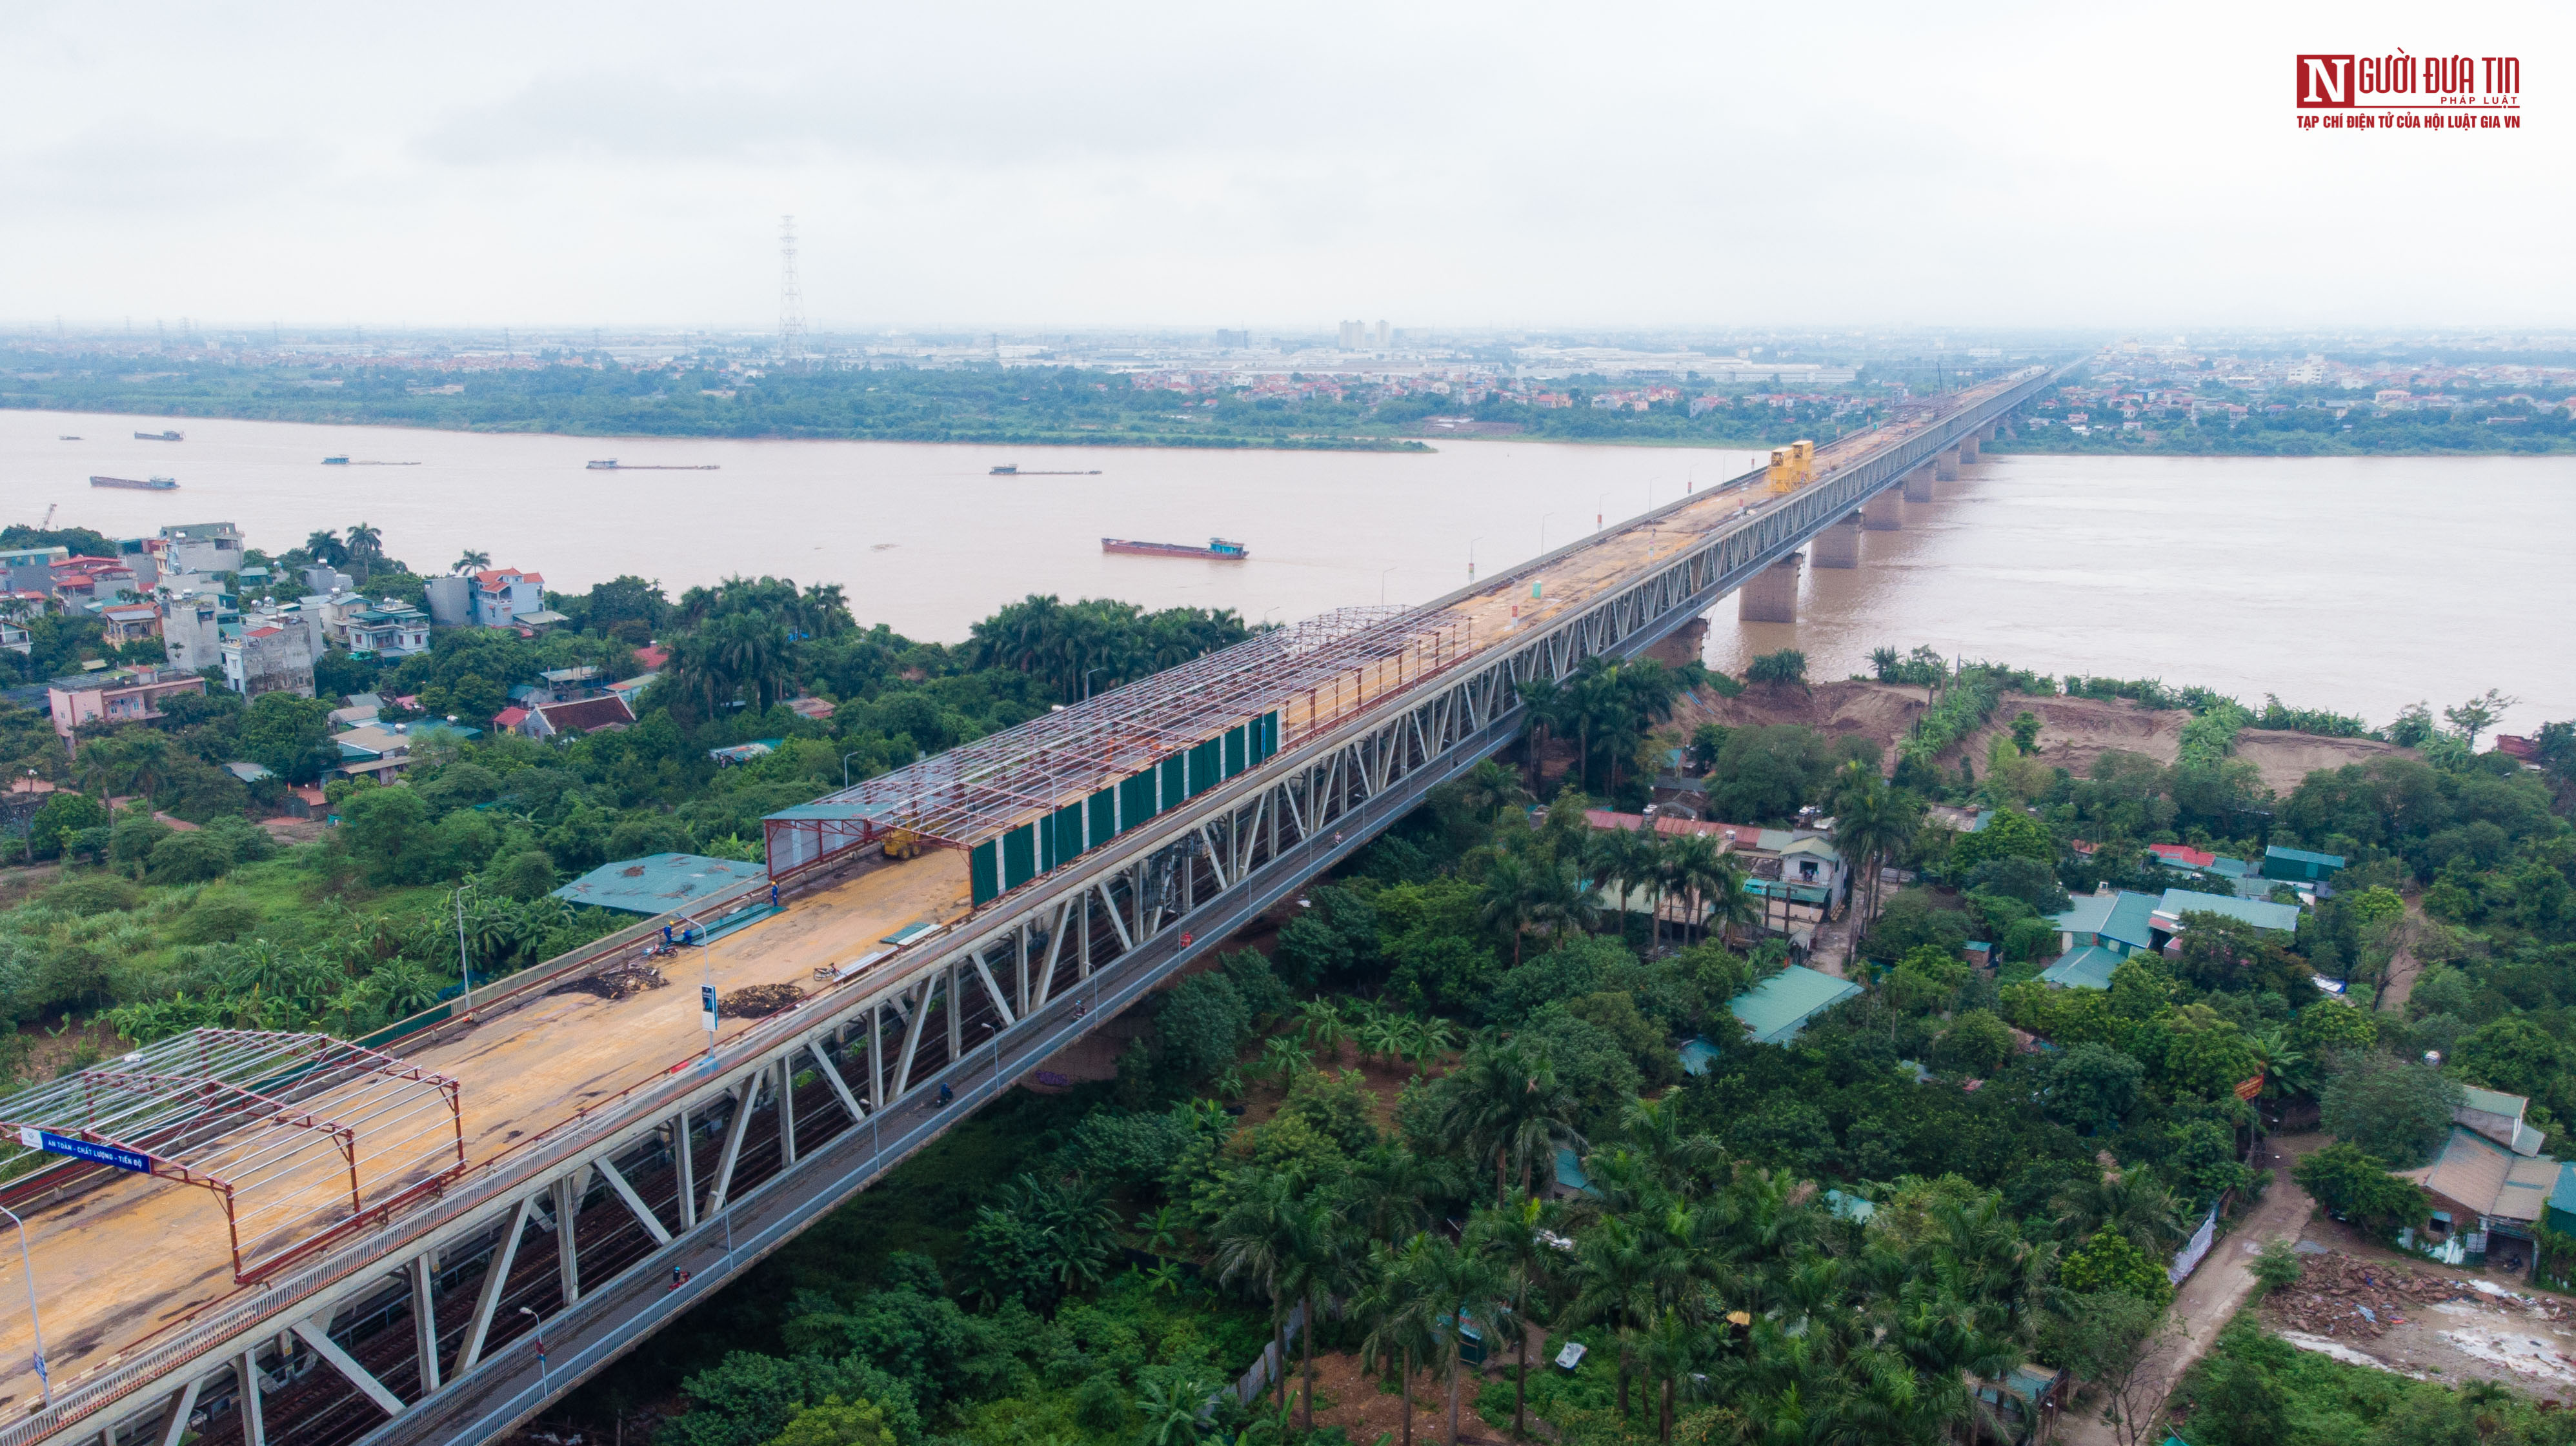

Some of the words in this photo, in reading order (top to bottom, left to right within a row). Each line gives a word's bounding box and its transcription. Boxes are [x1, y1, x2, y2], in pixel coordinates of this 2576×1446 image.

[57, 1141, 72, 1151] TOÀN
[77, 1145, 92, 1156] CHẤT
[94, 1150, 114, 1161] LƯỢNG
[119, 1154, 132, 1165] TIẾN
